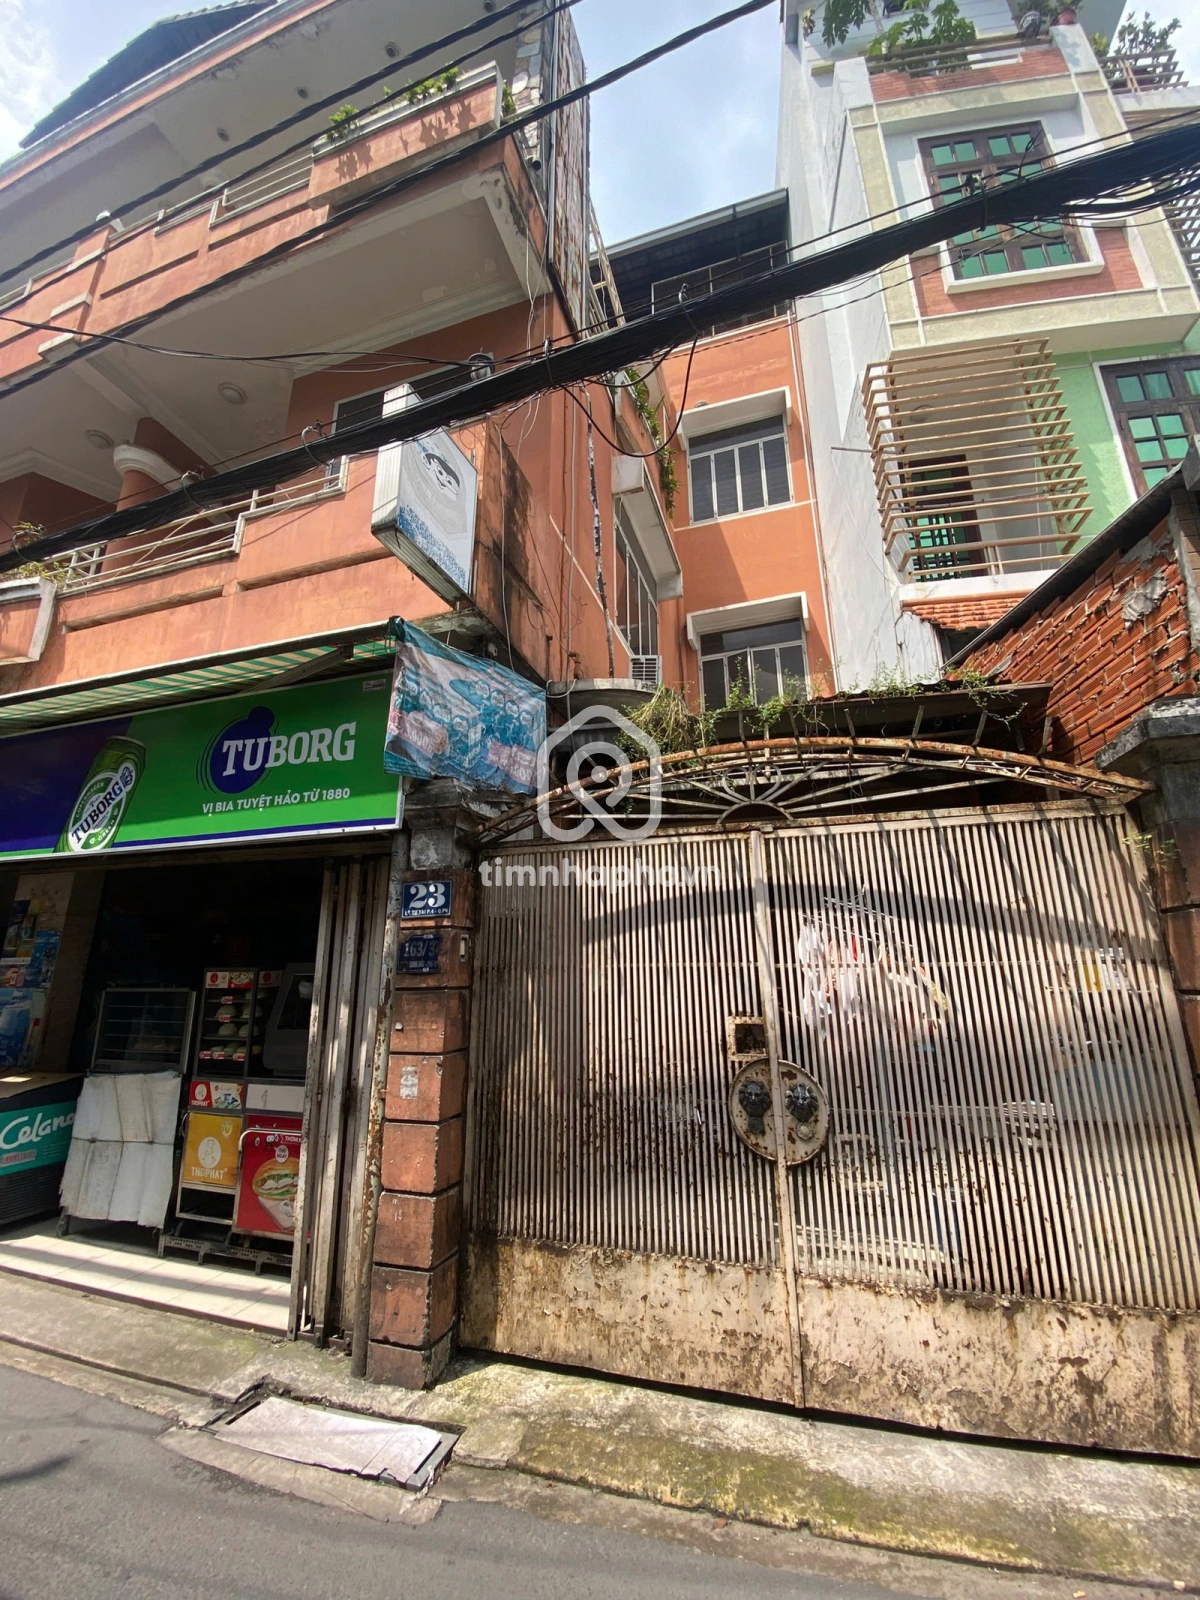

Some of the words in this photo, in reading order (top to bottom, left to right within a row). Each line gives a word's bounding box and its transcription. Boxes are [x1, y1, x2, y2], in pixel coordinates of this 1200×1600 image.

[222, 721, 357, 777] TUBORG
[71, 780, 123, 844] TUBORG
[202, 803, 214, 818] VỊ
[215, 801, 234, 813] BIA
[236, 794, 273, 812] TUYỆT
[274, 789, 301, 806] HẢO
[303, 788, 321, 802] TỪ
[322, 787, 351, 800] 1880
[408, 883, 446, 909] 23
